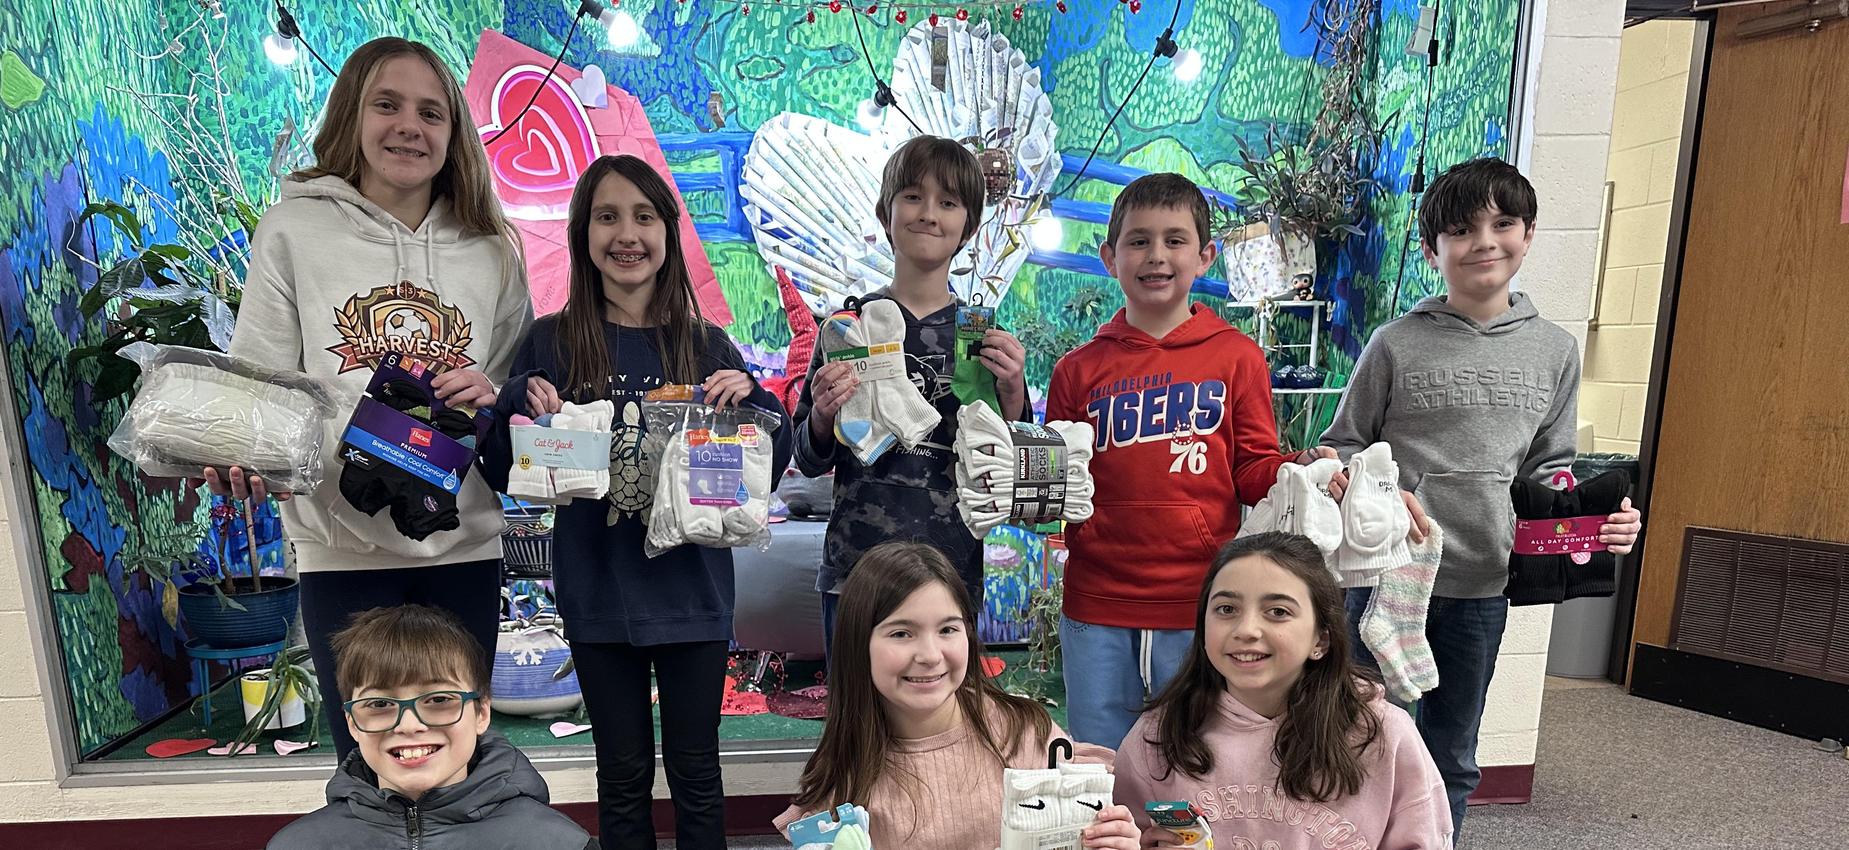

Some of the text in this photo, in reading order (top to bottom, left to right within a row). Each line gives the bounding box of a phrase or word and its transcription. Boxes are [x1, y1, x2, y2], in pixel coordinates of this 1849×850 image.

[358, 335, 453, 360] HARVEST
[388, 354, 398, 366] 6
[854, 360, 867, 372] 10
[1090, 372, 1172, 399] PHILADELPHIA
[1404, 367, 1550, 392] RUSSELL
[1406, 387, 1549, 413] ATHLETIC
[1087, 380, 1227, 453] 76ERS
[400, 442, 428, 460] PREMIUM
[534, 438, 547, 448] Cat
[554, 438, 574, 452] Jack
[695, 450, 711, 462] 10
[1169, 441, 1208, 474] 76
[371, 439, 406, 460] Breathable
[407, 455, 422, 468] Cool
[422, 462, 446, 479] Comfort
[520, 457, 530, 465] 10
[1564, 535, 1599, 543] COMFORT
[1190, 784, 1370, 850] SHINGTO
